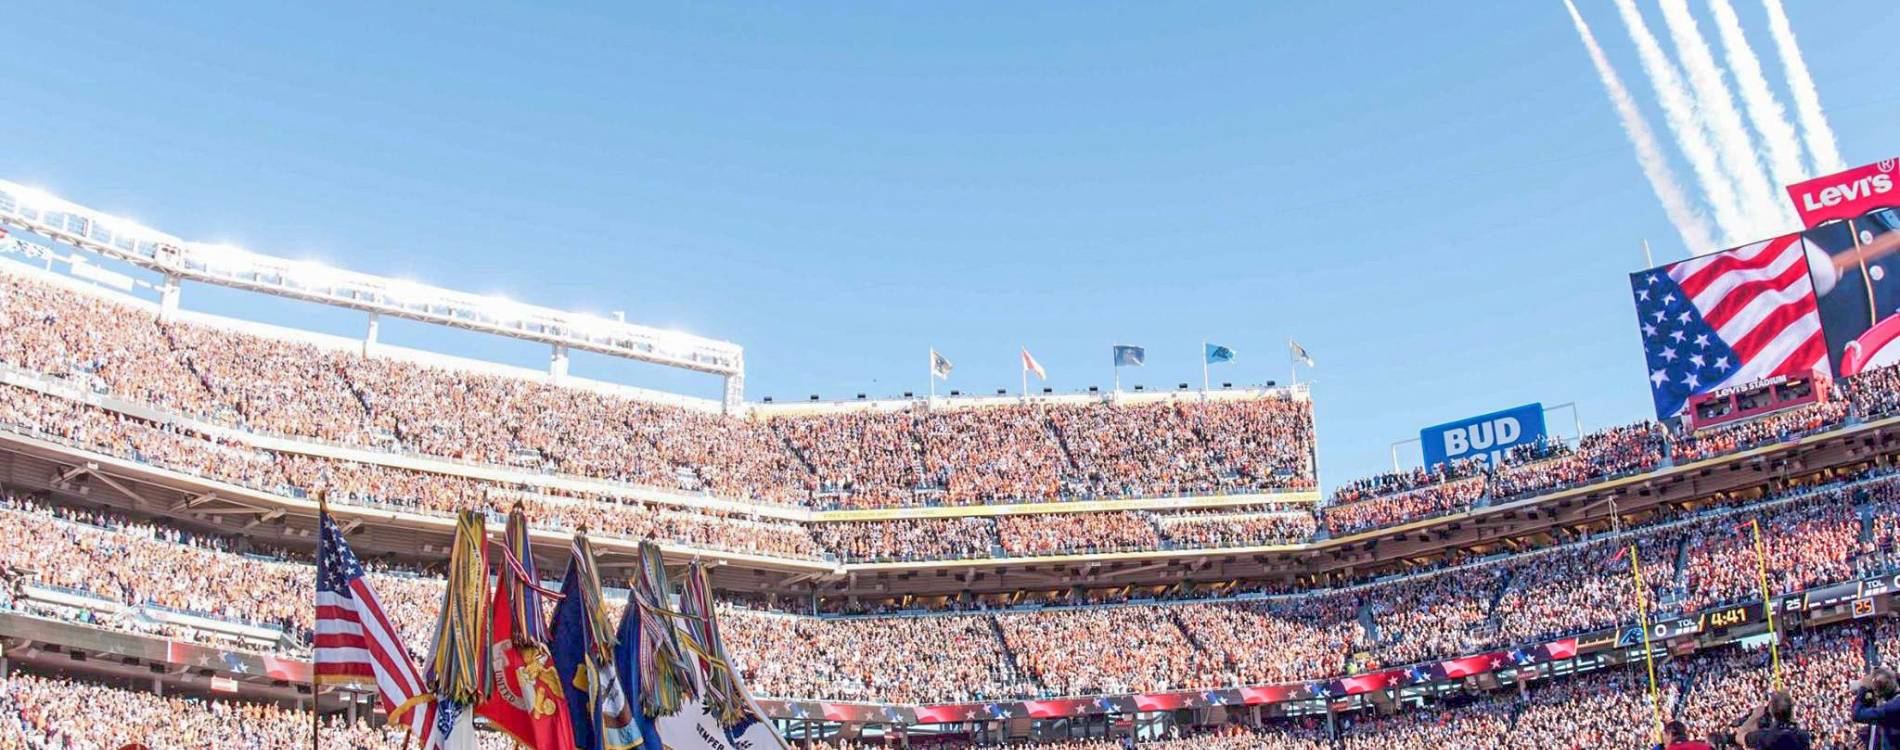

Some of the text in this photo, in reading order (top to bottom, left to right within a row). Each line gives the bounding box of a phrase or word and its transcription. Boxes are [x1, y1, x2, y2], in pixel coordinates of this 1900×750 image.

[1748, 374, 1788, 391] STADIUM
[1443, 416, 1521, 457] BUD
[1866, 579, 1885, 589] TOL
[1785, 599, 1801, 611] 25
[1855, 599, 1872, 616] 25
[1710, 607, 1747, 626] 4:41
[1654, 617, 1696, 638] 0 TOL
[495, 670, 516, 703] UNITED
[695, 722, 726, 750] SEMPER
